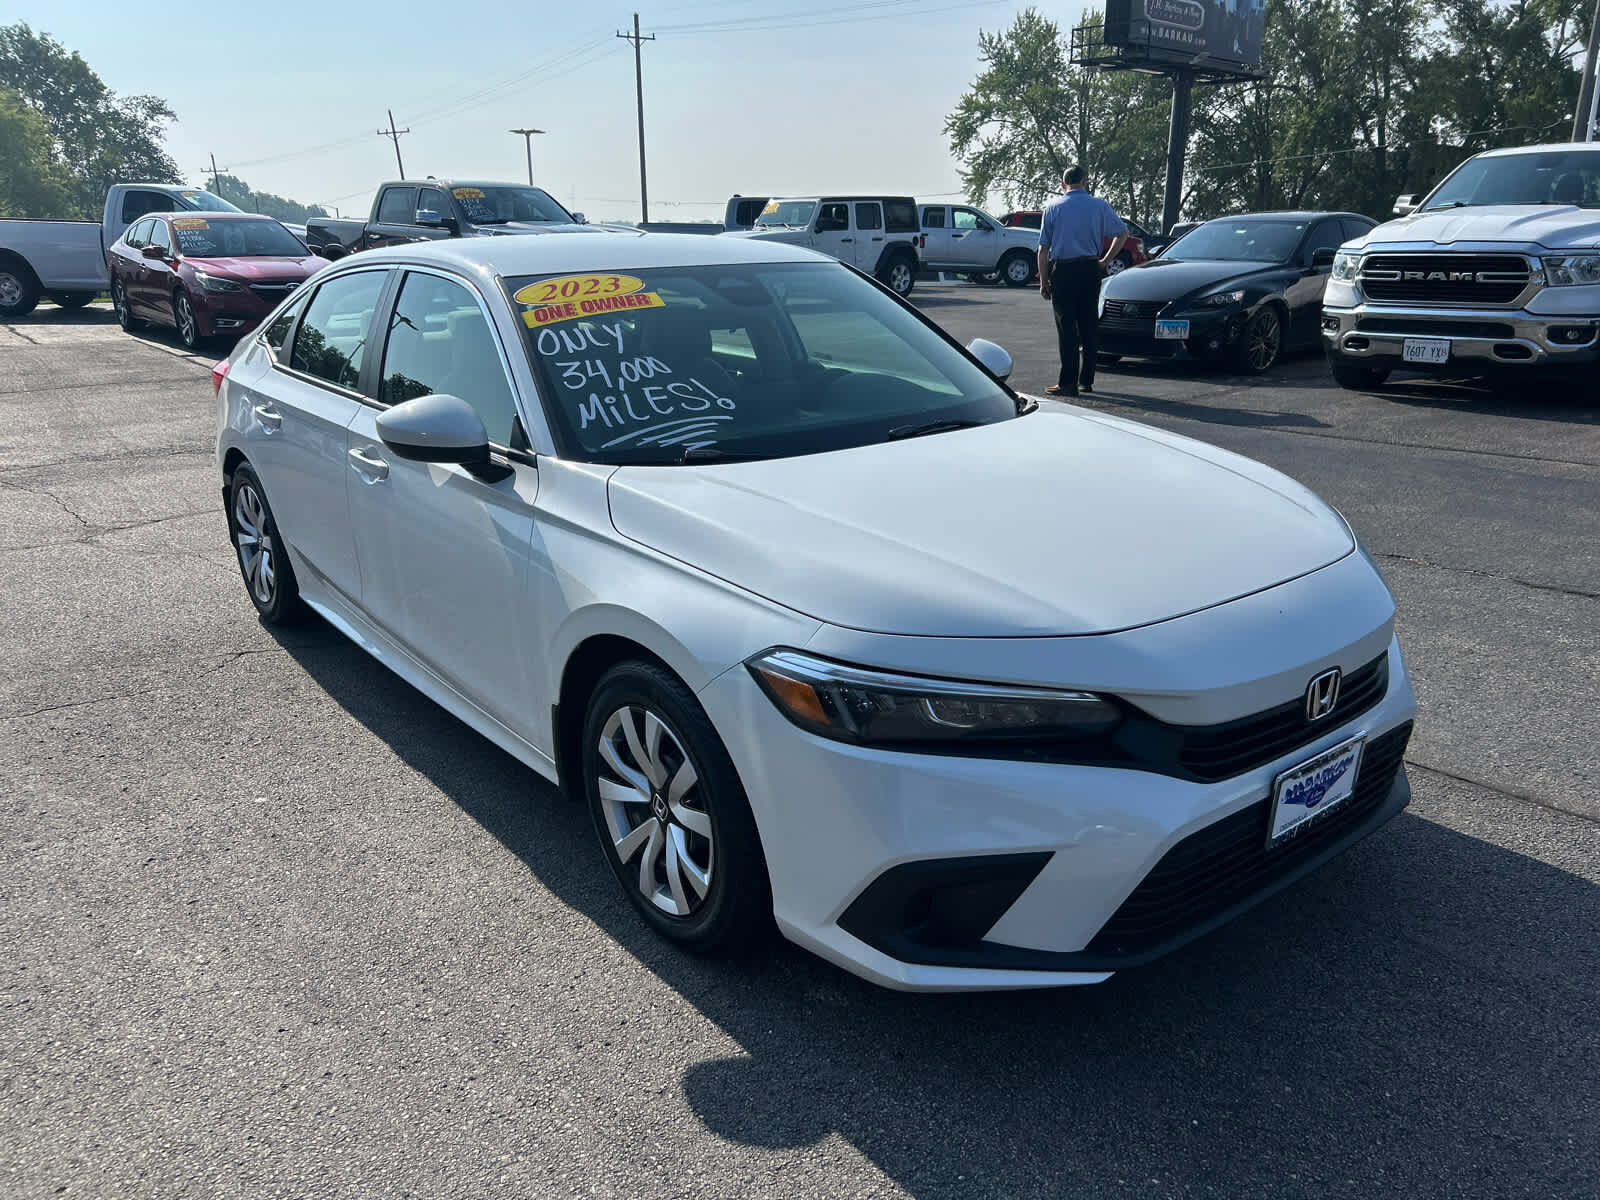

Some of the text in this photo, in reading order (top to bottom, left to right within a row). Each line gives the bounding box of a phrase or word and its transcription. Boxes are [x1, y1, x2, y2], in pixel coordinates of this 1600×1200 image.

[539, 277, 620, 302] 2023
[1404, 271, 1473, 282] RAM
[534, 293, 653, 323] ONE OWNER
[537, 323, 623, 356] ONLY
[555, 356, 673, 391] 34,000
